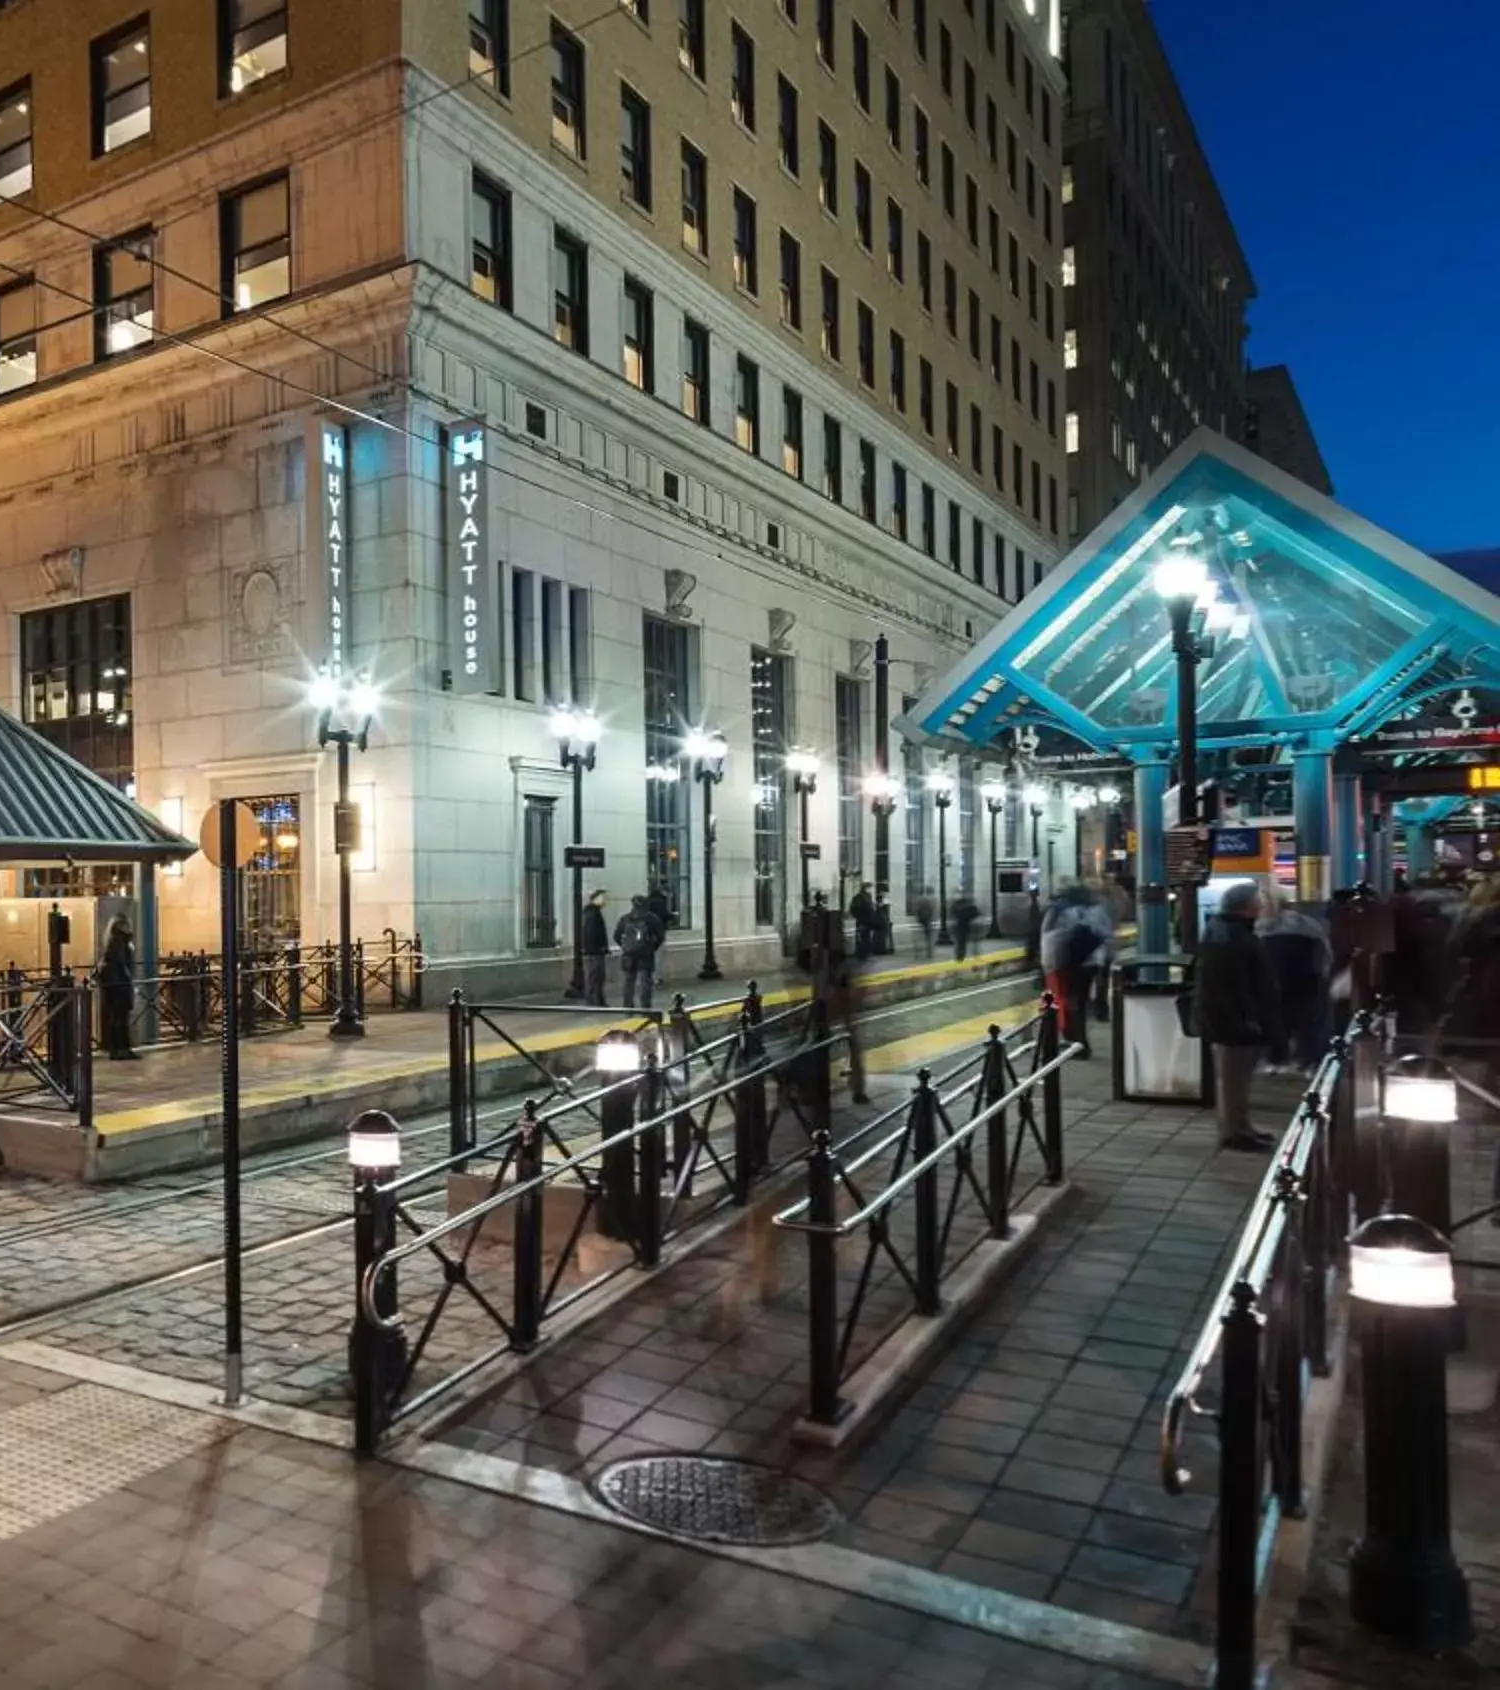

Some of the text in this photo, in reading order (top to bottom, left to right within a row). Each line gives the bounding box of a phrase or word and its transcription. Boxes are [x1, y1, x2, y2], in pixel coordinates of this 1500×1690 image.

[327, 473, 342, 587] HYATT
[459, 470, 479, 586] HYATT
[463, 595, 479, 675] house
